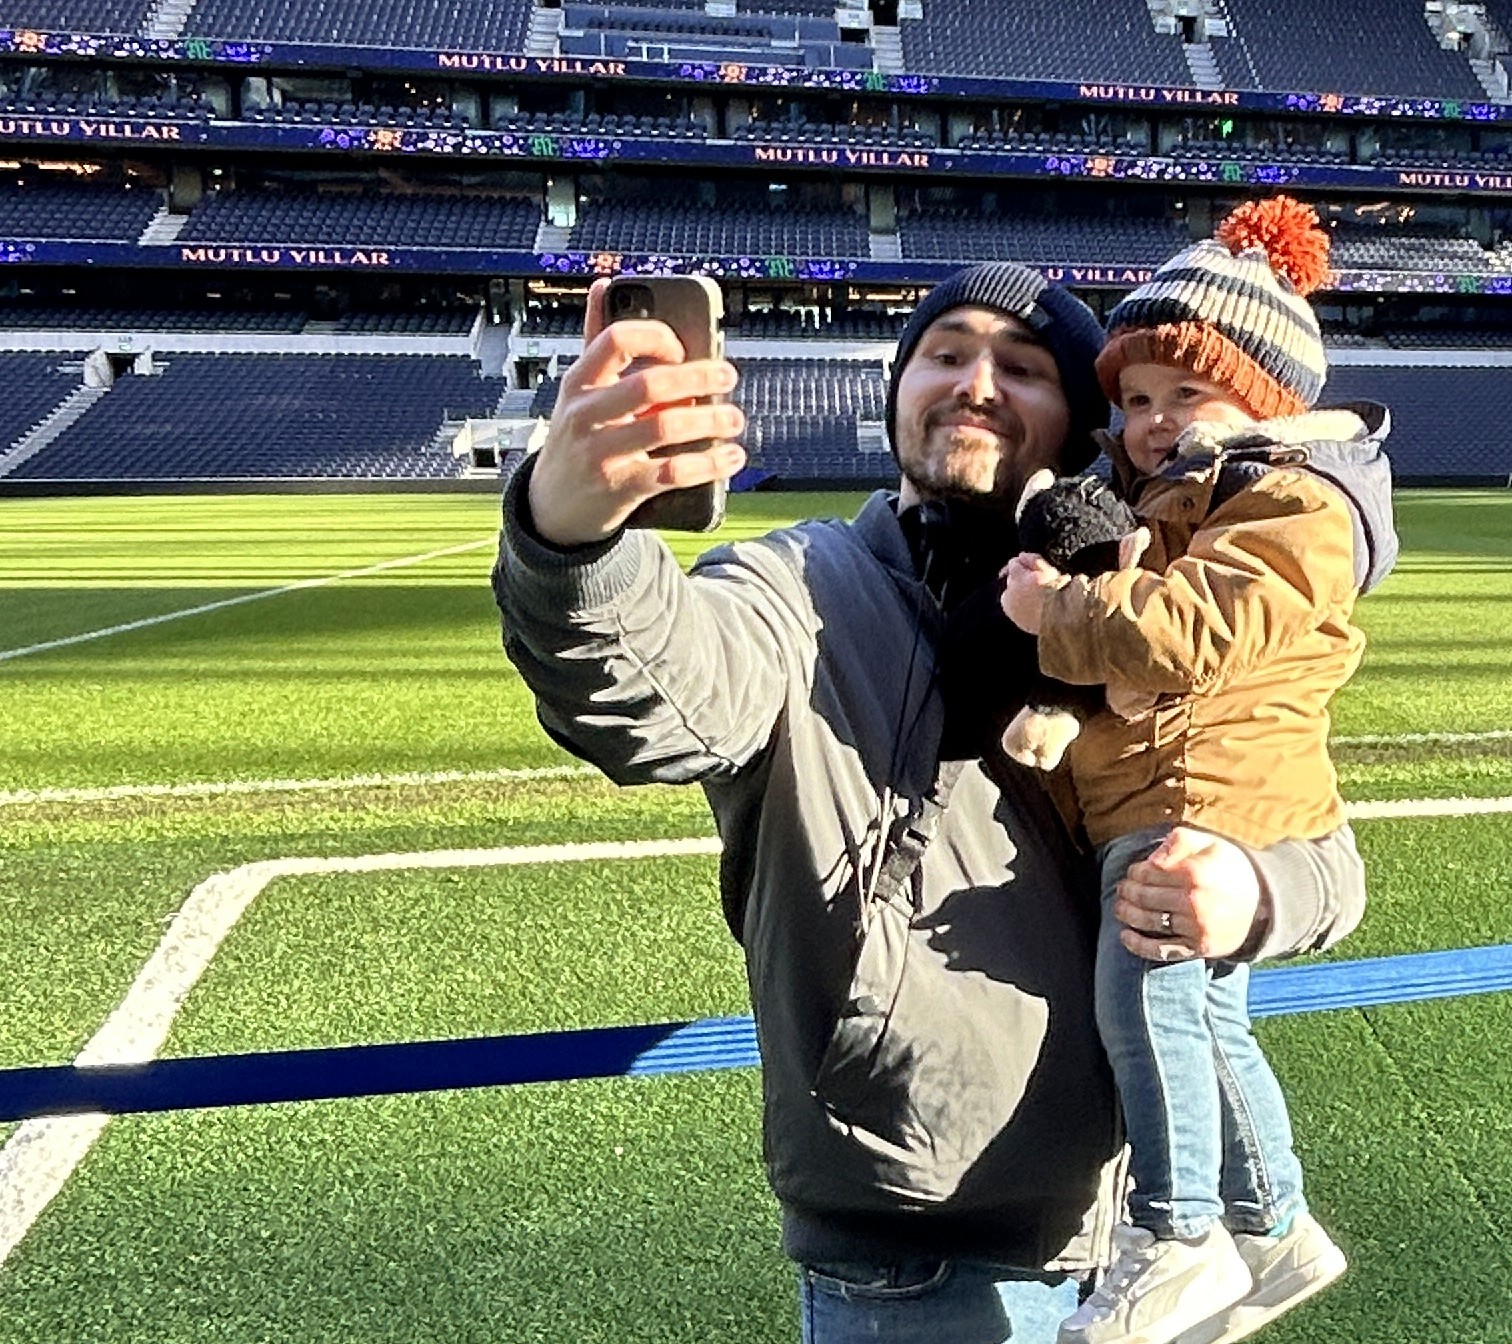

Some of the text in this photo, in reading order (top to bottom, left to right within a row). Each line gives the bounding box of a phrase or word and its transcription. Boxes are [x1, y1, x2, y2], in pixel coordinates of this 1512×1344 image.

[438, 54, 627, 75] MUTLU YILLAR
[1080, 85, 1239, 106] MUTLU YILLAR
[0, 119, 181, 140] UTLU YILLAR
[755, 148, 930, 168] MUTLU YILLAR
[1399, 172, 1471, 187] MUTLU
[181, 248, 390, 266] MUTLU YILLAR
[1072, 268, 1151, 283] YILLAR
